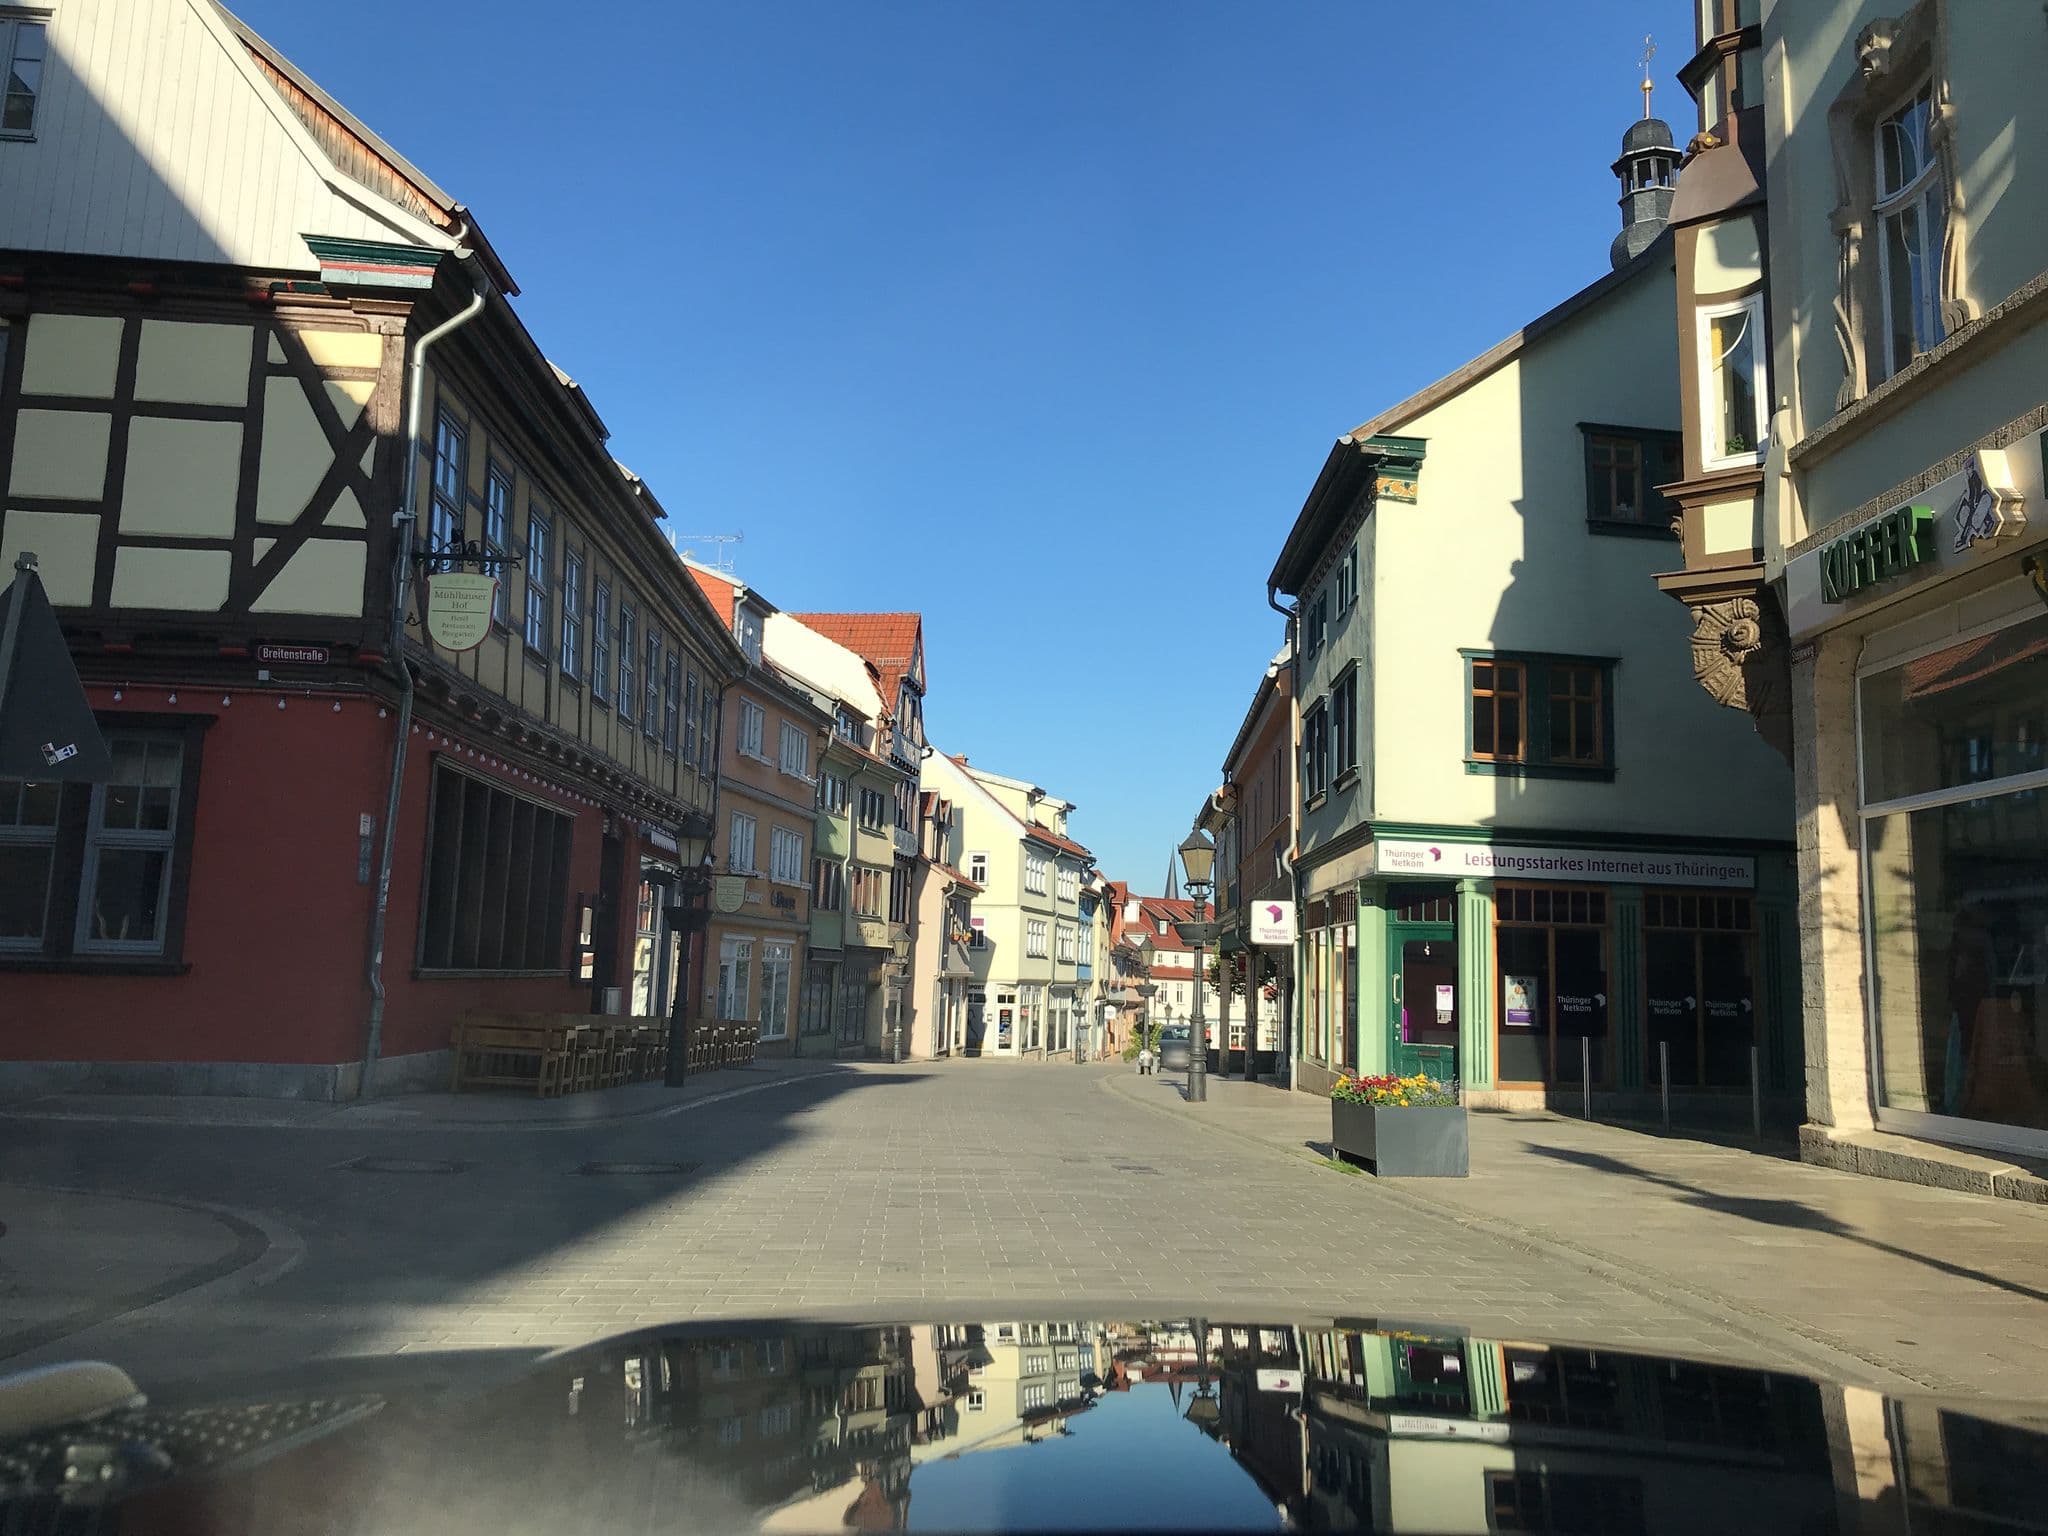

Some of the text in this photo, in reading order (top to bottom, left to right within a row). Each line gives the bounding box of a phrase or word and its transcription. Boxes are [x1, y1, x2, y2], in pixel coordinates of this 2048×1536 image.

[1819, 505, 1928, 604] KOFFER
[452, 601, 467, 609] Hof
[263, 648, 324, 661] Breitenstraße
[1384, 849, 1425, 859] Thüringer
[1392, 858, 1425, 868] Netkom
[1465, 853, 1749, 880] Leistungsstarkes Internet aus Thüringen.
[1557, 996, 1592, 1005] Thüringer
[1563, 1004, 1592, 1012] Netkom
